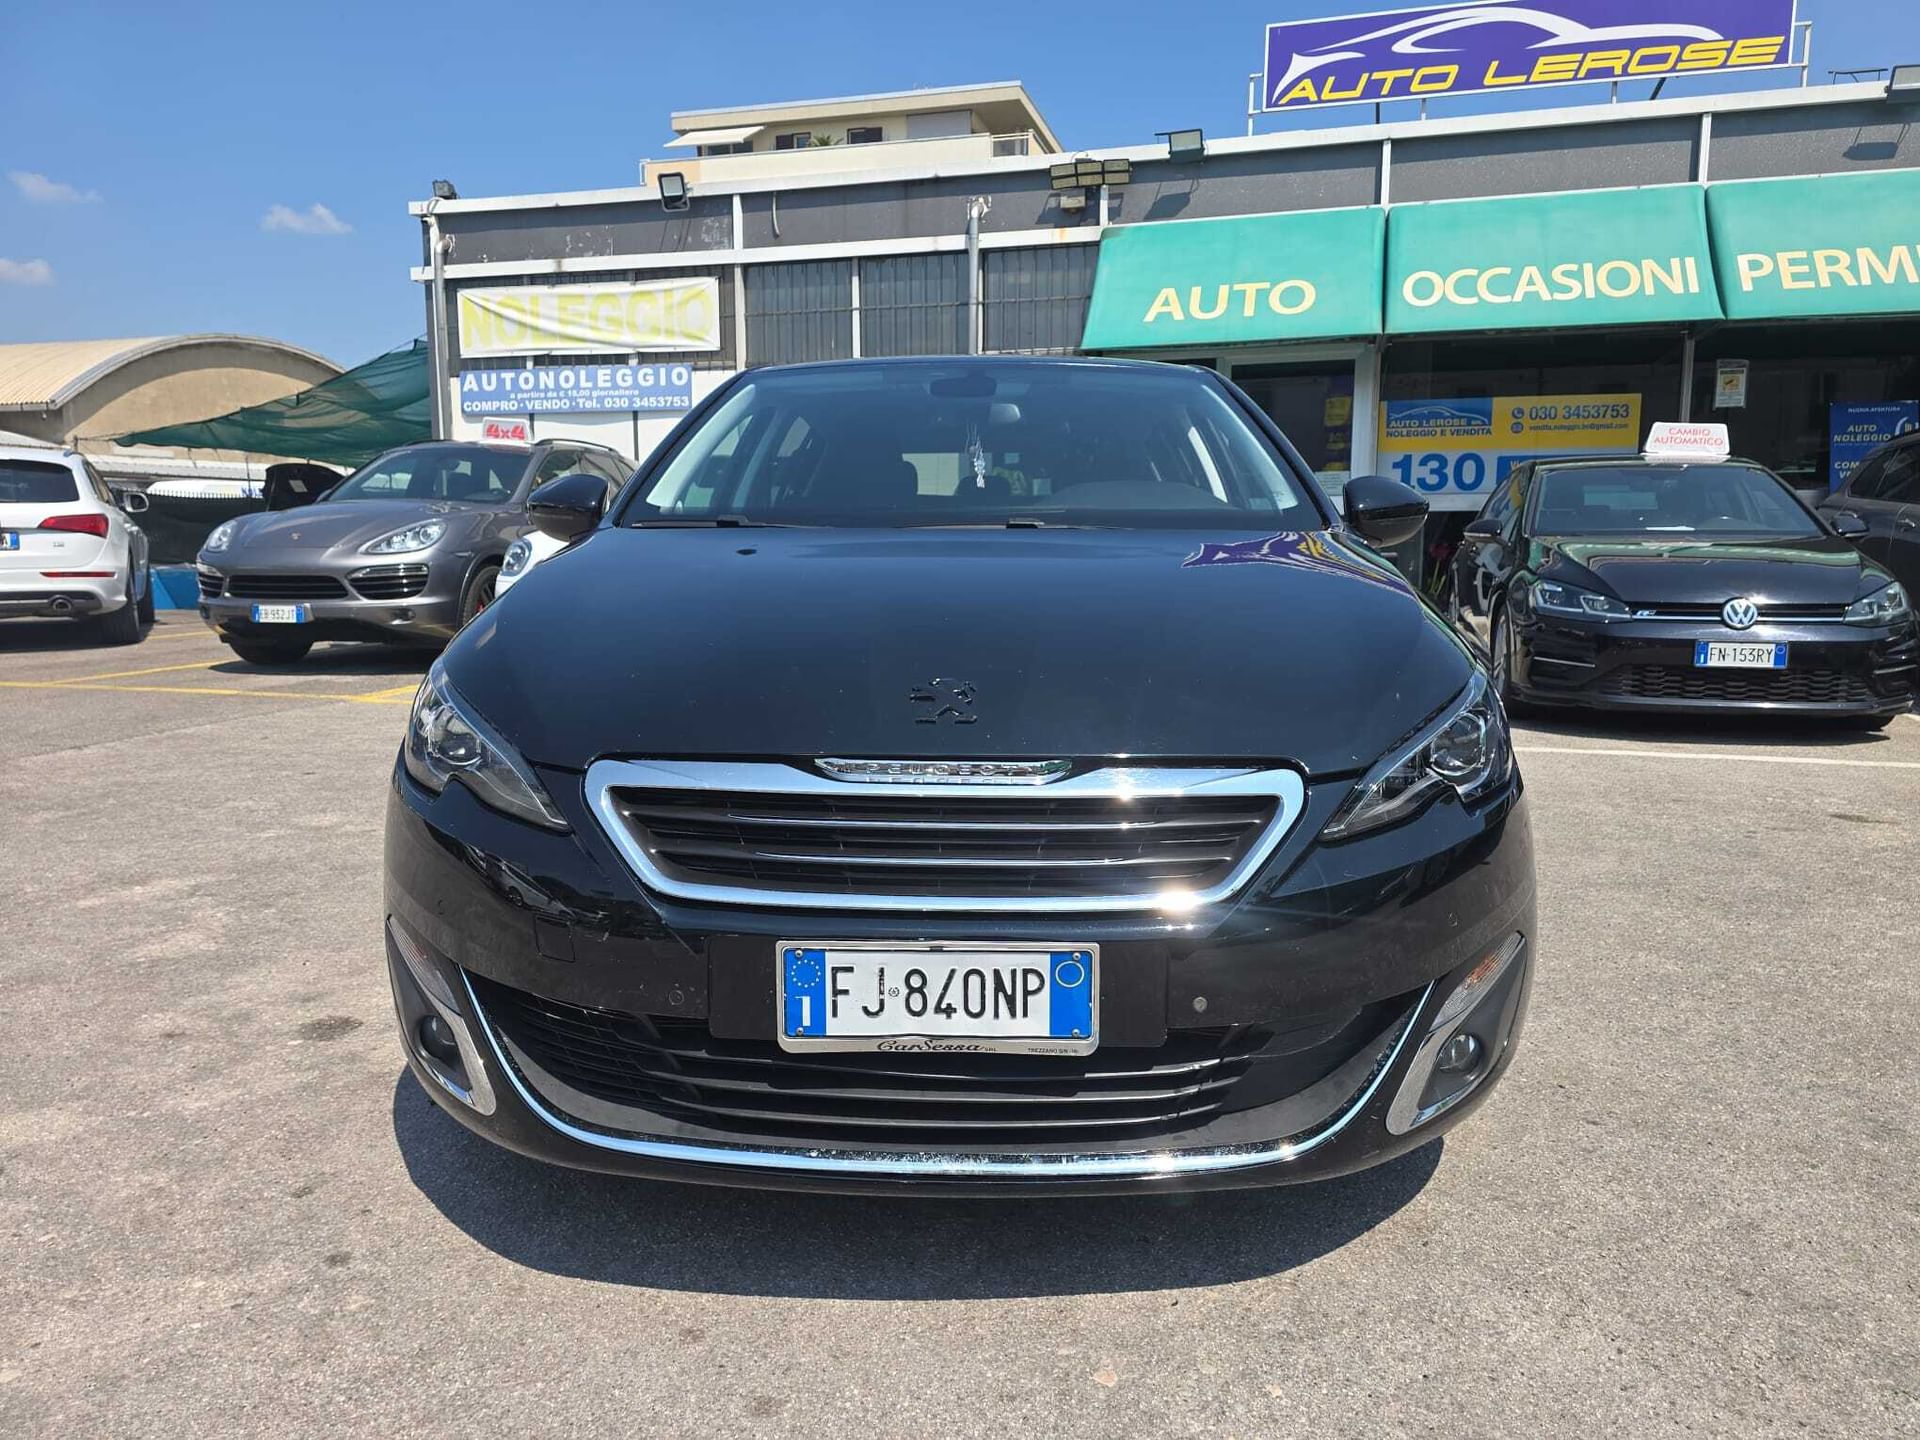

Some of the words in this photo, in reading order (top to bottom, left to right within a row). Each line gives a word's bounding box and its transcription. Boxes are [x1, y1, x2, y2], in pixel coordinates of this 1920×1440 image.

[1278, 64, 1459, 105] AUTO
[1483, 36, 1785, 86] LEROSE
[1142, 278, 1316, 323] AUTO
[1401, 256, 1700, 307] OCCASIONI
[1736, 244, 1920, 292] PERM
[463, 287, 713, 348] NOLEGGIO
[463, 367, 689, 391] AUTONOLEGGIO
[463, 399, 517, 412] COMPRO
[527, 398, 569, 410] VENDO
[577, 397, 600, 409] Tel.
[604, 397, 629, 408] 030
[632, 395, 689, 408] 3453753
[1529, 405, 1558, 420] 030
[1562, 403, 1630, 420] 3453753
[1389, 419, 1420, 428] AUTO
[1423, 418, 1467, 427] LEROSE
[1847, 424, 1877, 433] AUTO
[486, 424, 525, 440] 4x4
[1386, 428, 1437, 438] NOLEGGIO
[1441, 428, 1447, 437] E
[1449, 427, 1492, 437] VENDITA
[1669, 427, 1711, 437] CAMBIO
[1833, 433, 1891, 442] NOLEGGIO
[1654, 436, 1724, 446] AUTOMATICO
[1392, 452, 1486, 492] 130
